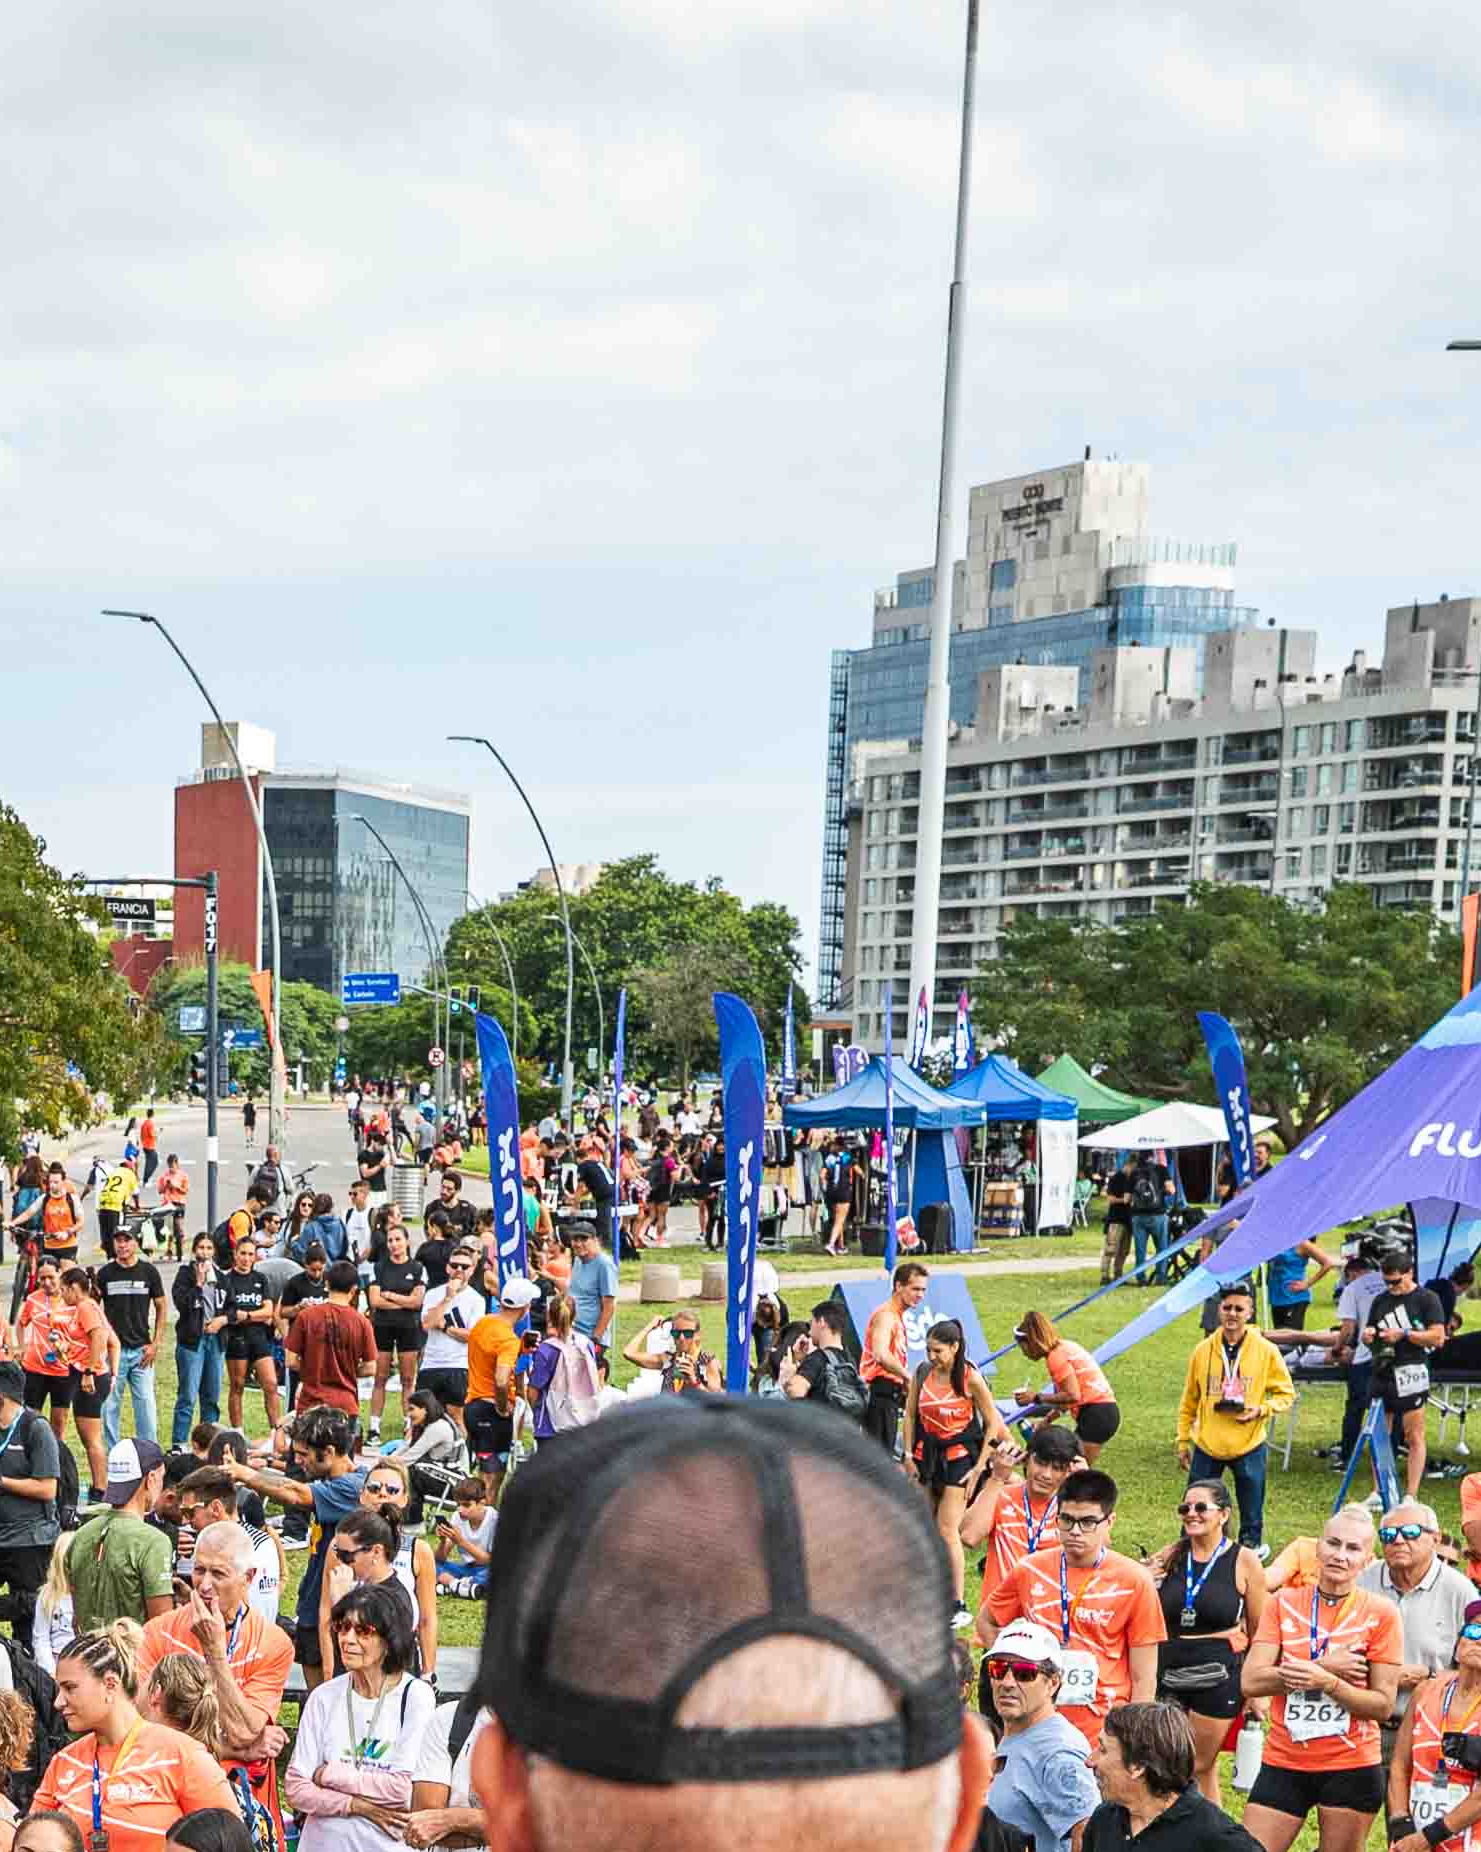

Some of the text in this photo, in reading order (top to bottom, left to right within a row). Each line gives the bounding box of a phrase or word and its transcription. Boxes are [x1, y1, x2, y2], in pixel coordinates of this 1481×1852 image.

[106, 901, 149, 915] FRANCIA
[204, 897, 217, 952] F017
[1287, 1703, 1347, 1723] 5262
